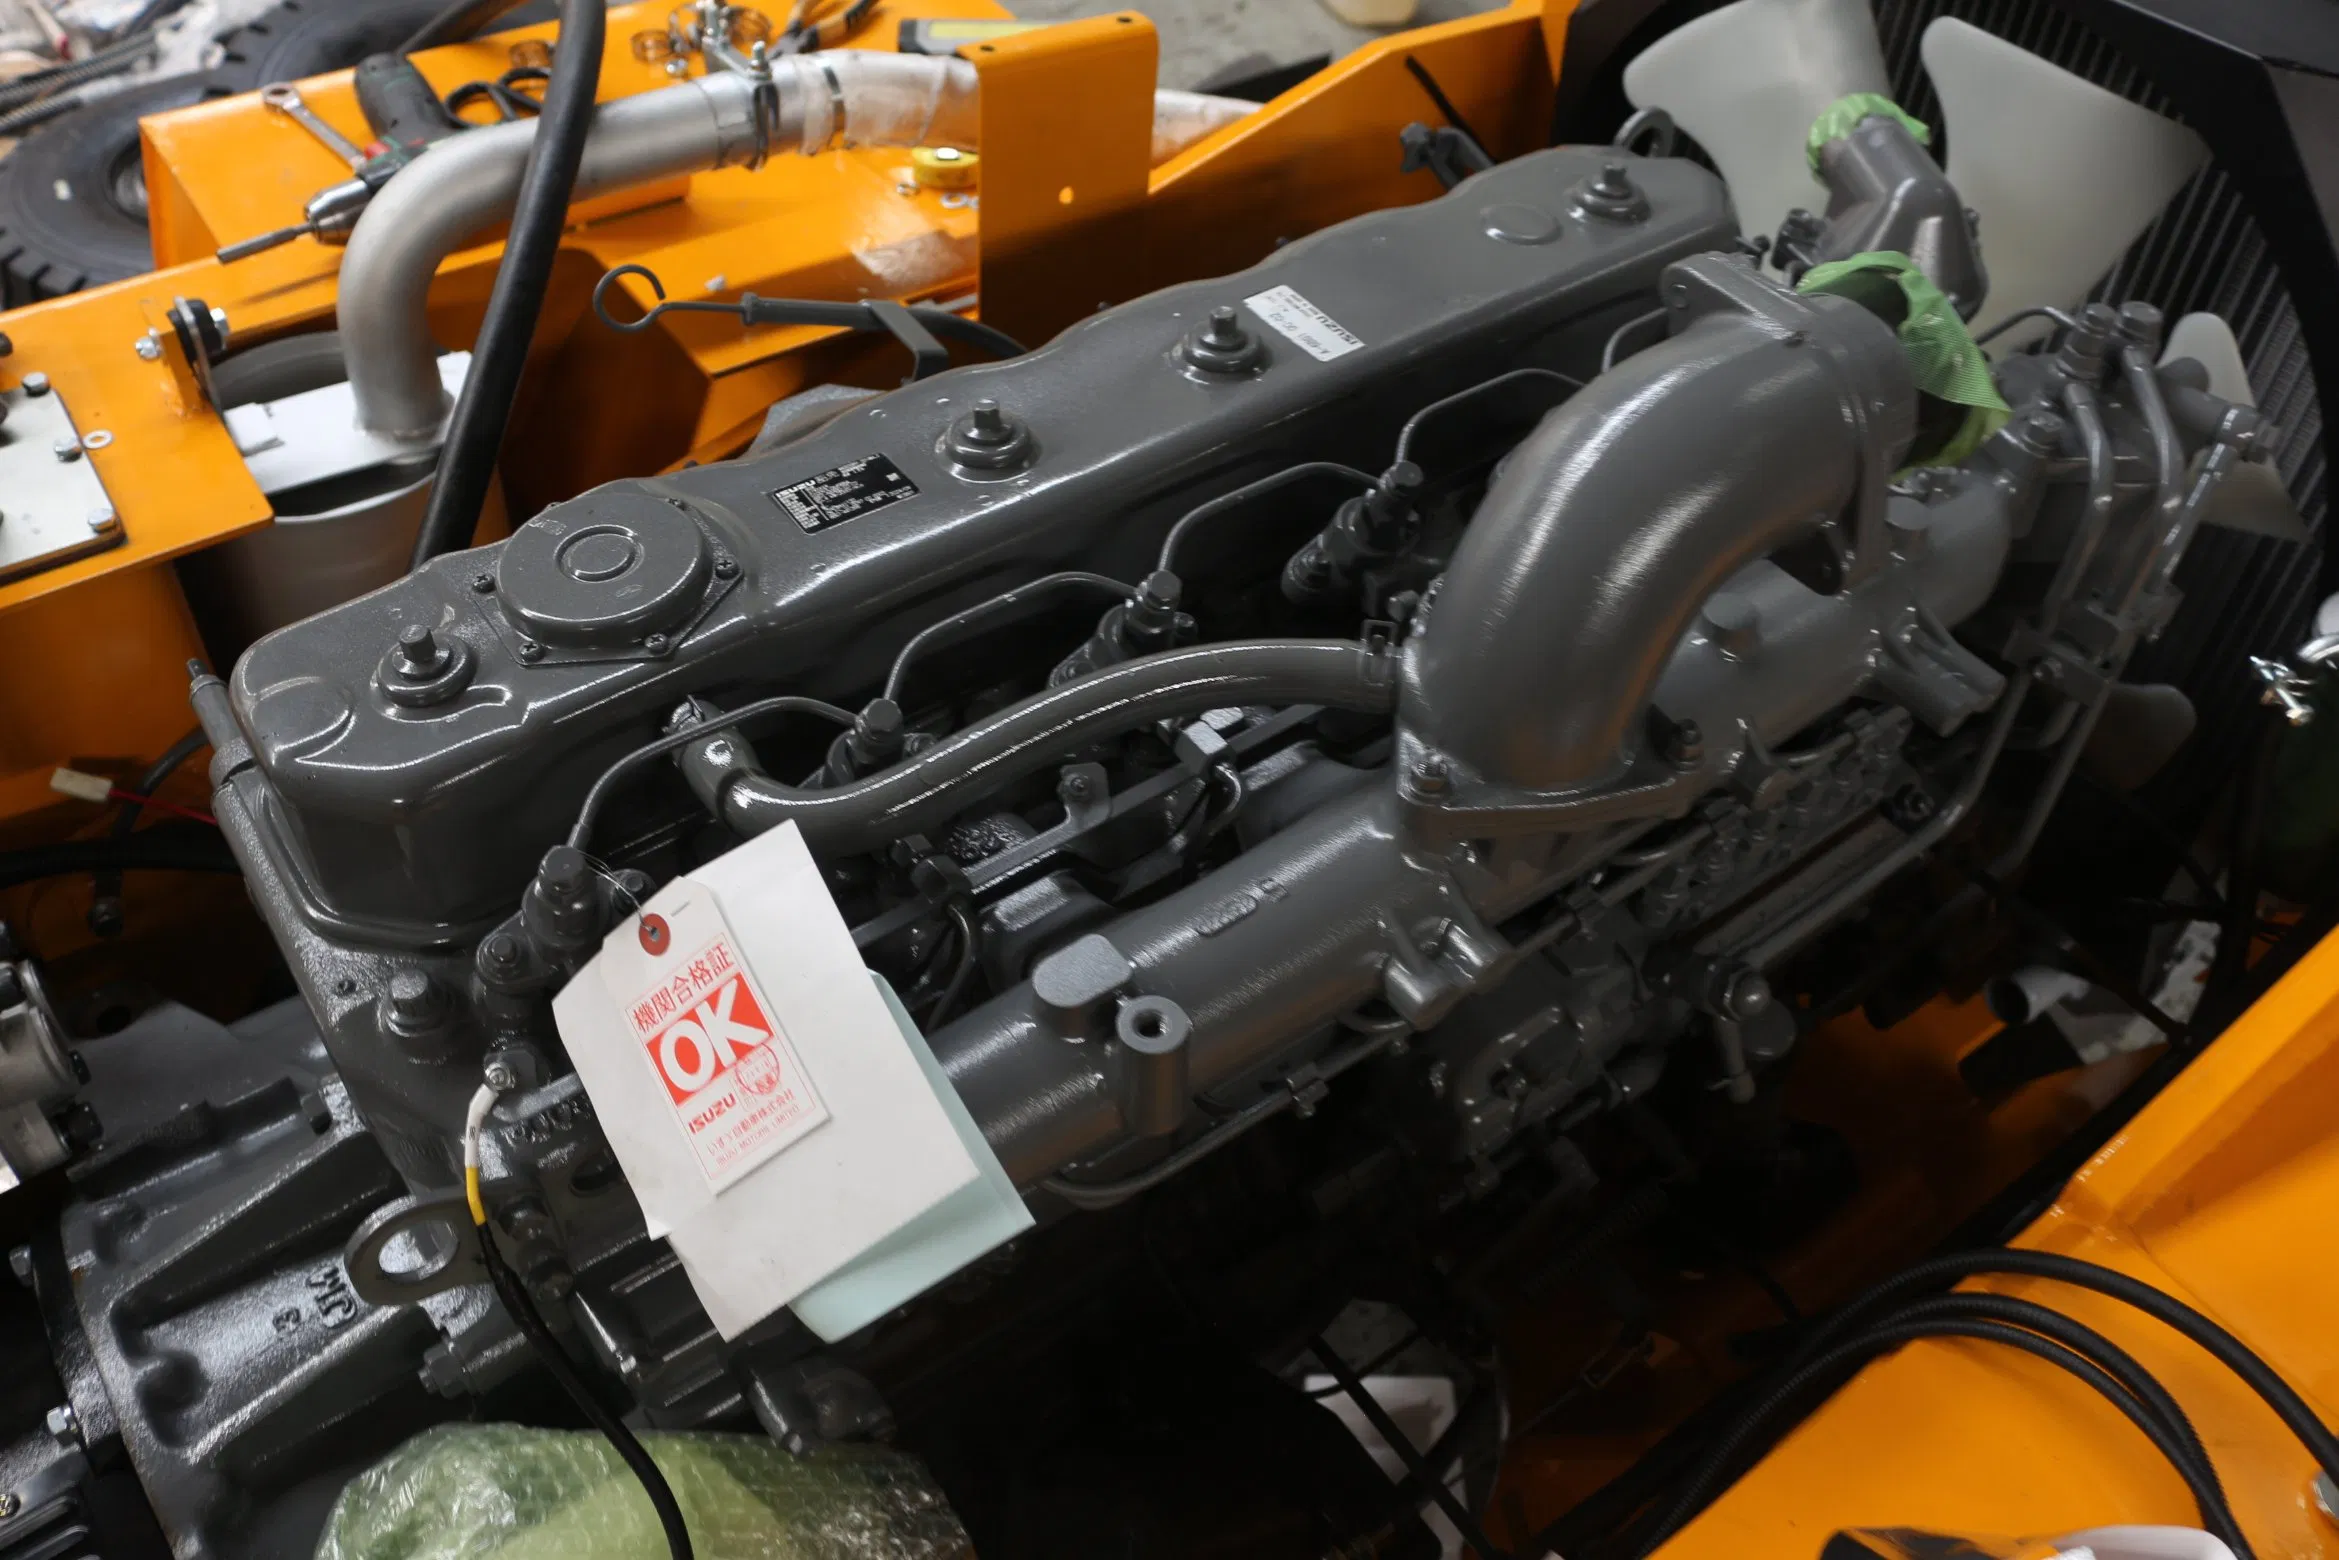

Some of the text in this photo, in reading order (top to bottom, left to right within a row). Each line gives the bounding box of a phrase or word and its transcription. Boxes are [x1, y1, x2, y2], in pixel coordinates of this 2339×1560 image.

[1314, 314, 1358, 345] ISUZU
[774, 478, 816, 498] ISUZU
[632, 943, 735, 1033] 機関合格証
[658, 976, 769, 1093] OK
[687, 1090, 737, 1135] ISUZU
